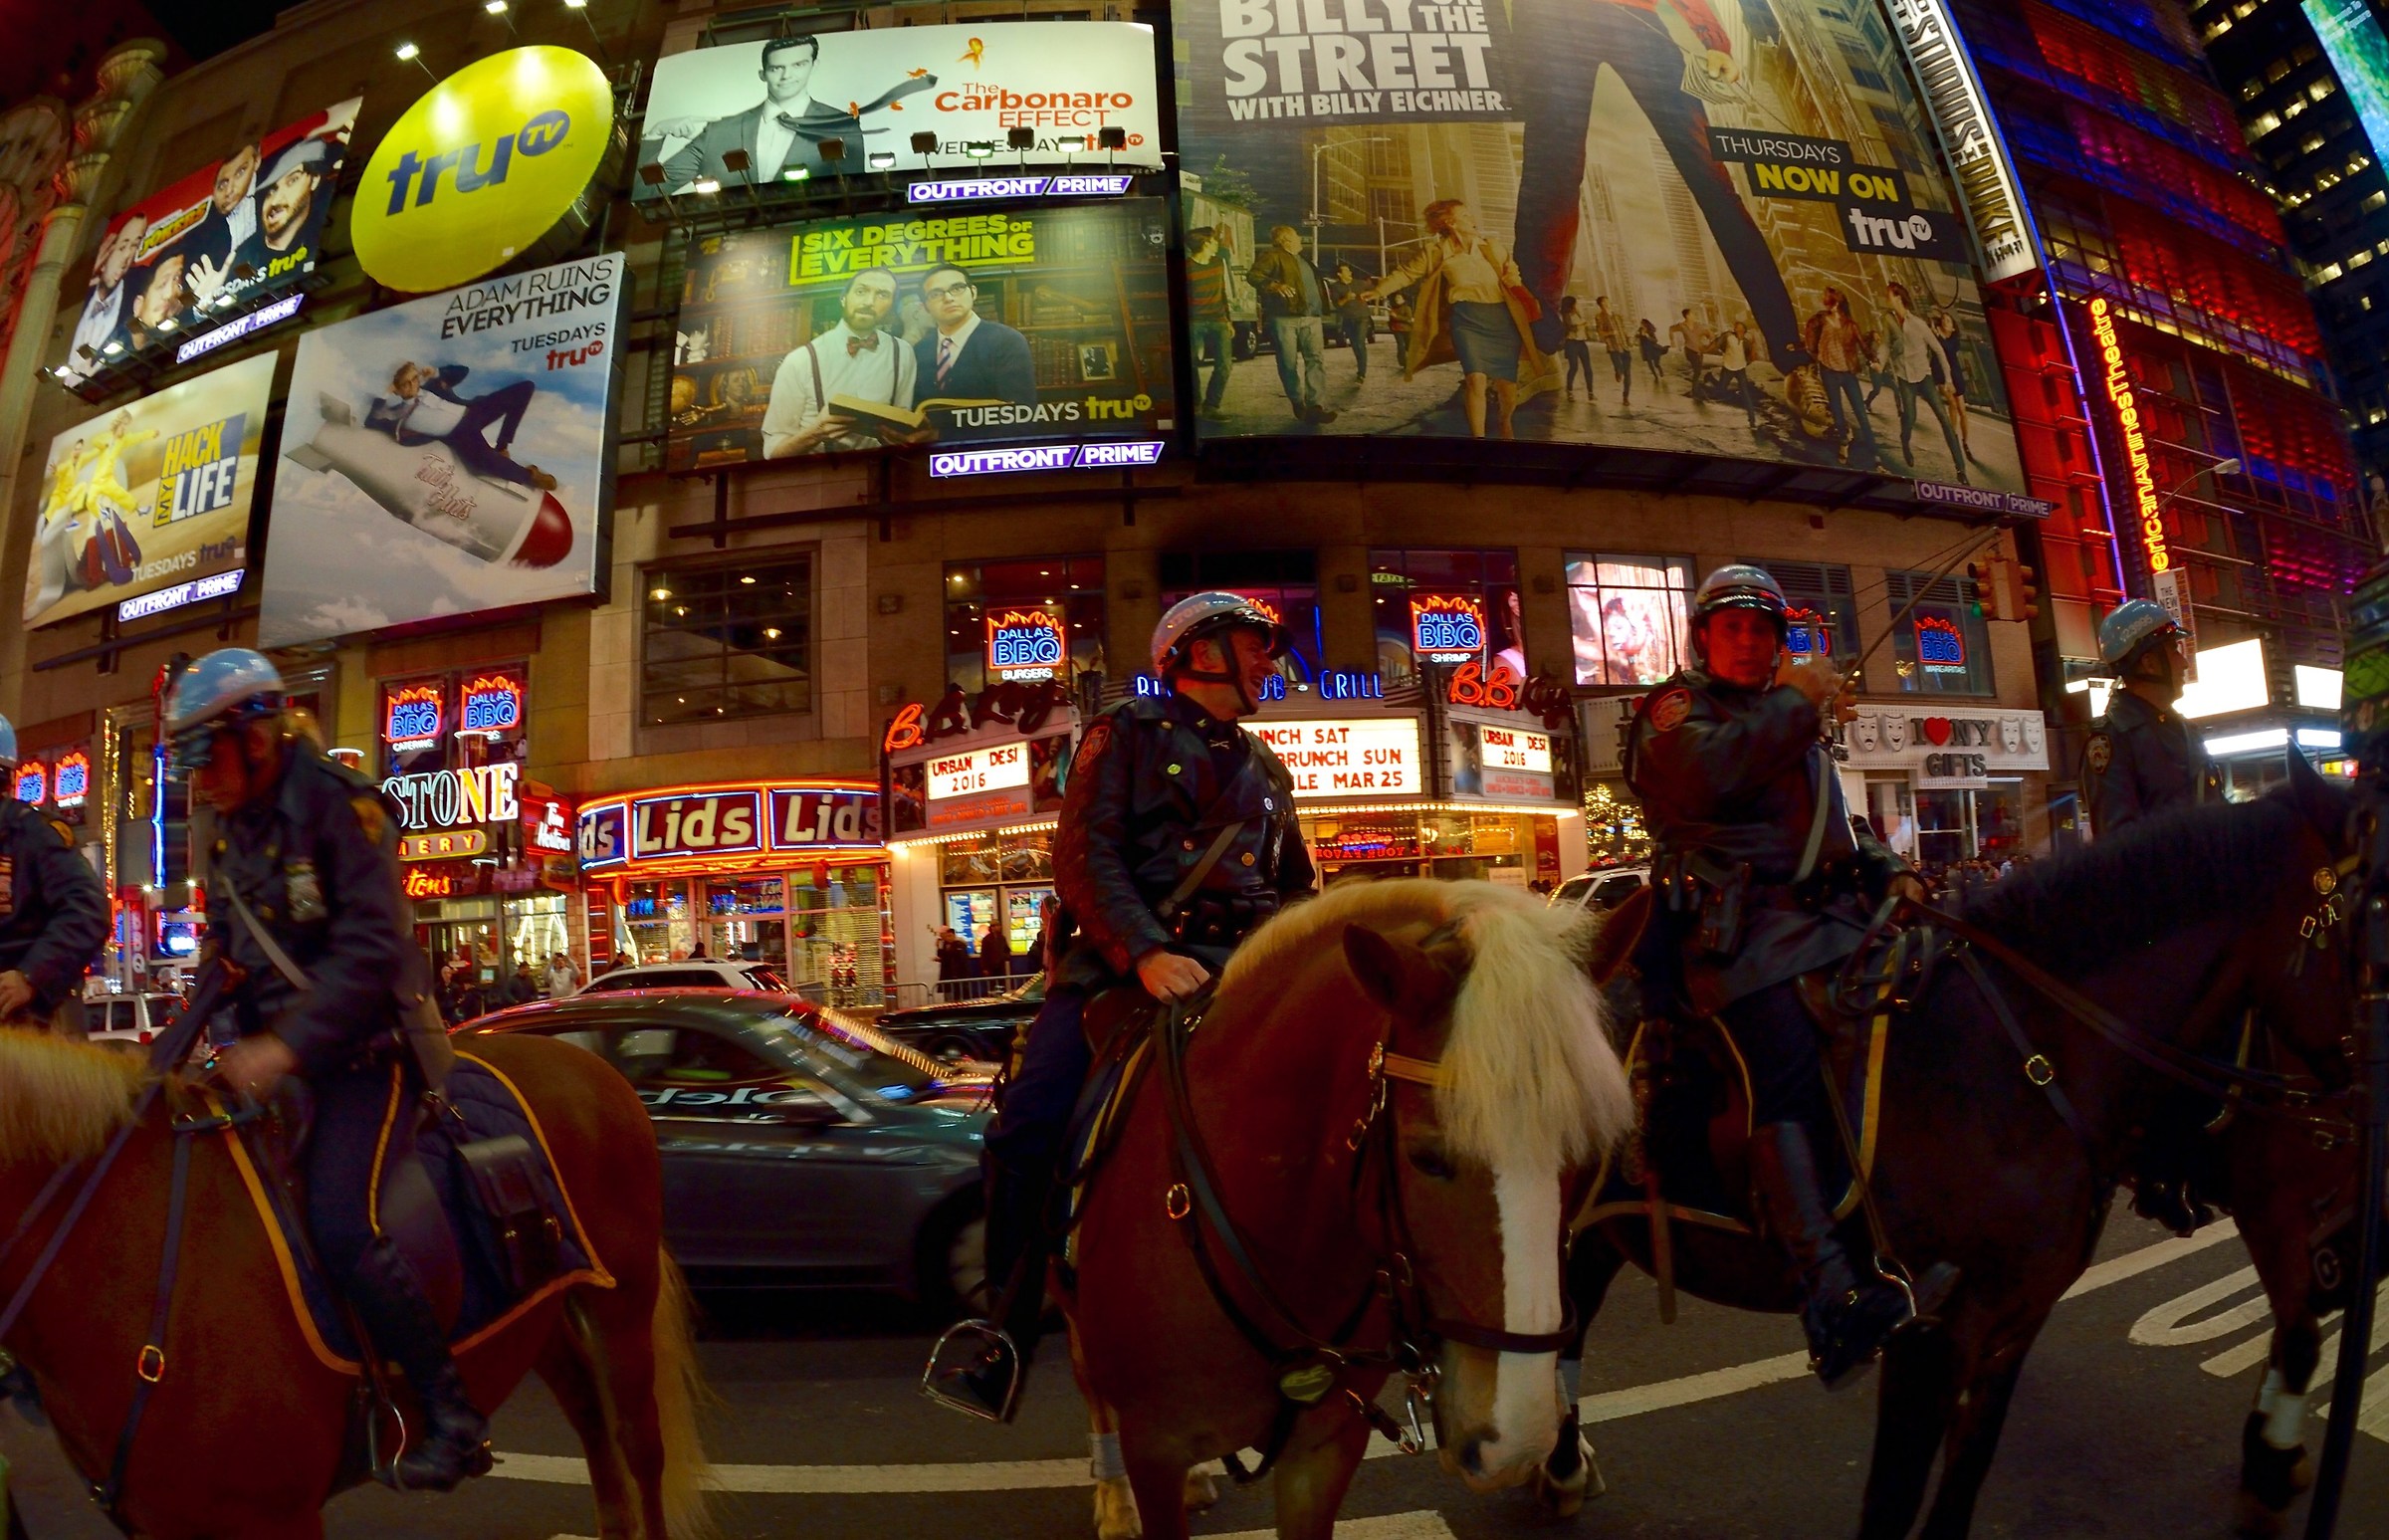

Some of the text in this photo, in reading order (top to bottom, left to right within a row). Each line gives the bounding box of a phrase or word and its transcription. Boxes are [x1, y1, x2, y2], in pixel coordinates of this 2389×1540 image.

[1219, 0, 1413, 38] BILLY
[1417, 5, 1489, 32] THE
[1222, 33, 1492, 97] STREET
[962, 82, 999, 96] The
[1902, 13, 1985, 149] STUDIOS
[935, 90, 1134, 112] Carbonaro
[1227, 91, 1505, 120] WITH BILLY EICHNER
[998, 110, 1111, 128] EFFECT
[1715, 134, 1842, 164] THURSDAYS
[913, 177, 1124, 200] OUTFRONT PRIME
[1755, 162, 1899, 202] NOW ON
[1956, 153, 2020, 247] DUKE
[802, 214, 1032, 254] SIX DEGREES OF
[800, 233, 1035, 278] EVERYTHING
[445, 258, 613, 317] ADAM RUINS
[440, 283, 610, 340] EVERYTHING
[179, 298, 298, 360] OUTFRONT PRIME
[511, 322, 606, 353] TUESDAYS
[951, 401, 1080, 428] TUESDAYS
[161, 418, 227, 478] HACK
[935, 444, 1155, 474] OUTFRONT PRIME
[157, 482, 174, 522] MY
[171, 455, 238, 522] LIFE
[1920, 482, 2050, 516] OUTFRONT PRIME
[131, 550, 197, 584] TUESDAYS
[120, 573, 239, 619] OUTFRONT PRIME
[1420, 612, 1474, 624] DALLAS
[997, 626, 1054, 640] DALLAS
[1417, 623, 1481, 649] BBQ
[1921, 630, 1955, 641] DALLAS
[992, 637, 1061, 666] BBQ
[1430, 653, 1472, 663] SHRIMP
[1920, 639, 1963, 662] BBQ
[1001, 667, 1053, 680] BURGERS
[1924, 664, 1967, 675] MARGARITAS
[469, 689, 513, 706] DALLAS
[1319, 669, 1386, 701] GRILL
[394, 701, 435, 716] DALLAS
[464, 700, 518, 731] BBQ
[390, 711, 438, 740] BBQ
[1314, 727, 1350, 744] SAT
[1910, 718, 1994, 747] I NY
[1483, 729, 1548, 752] URBAN DESI
[932, 747, 1019, 776] URBAN DESI
[1363, 748, 1403, 766] SUN
[1503, 751, 1527, 767] 2016
[1926, 753, 1987, 777] GIFTS
[952, 771, 986, 792] 2016
[1333, 770, 1375, 789] MAR
[1381, 770, 1404, 787] 25
[381, 762, 520, 830] STONE
[637, 797, 753, 852] Lids
[784, 793, 883, 842] Lids
